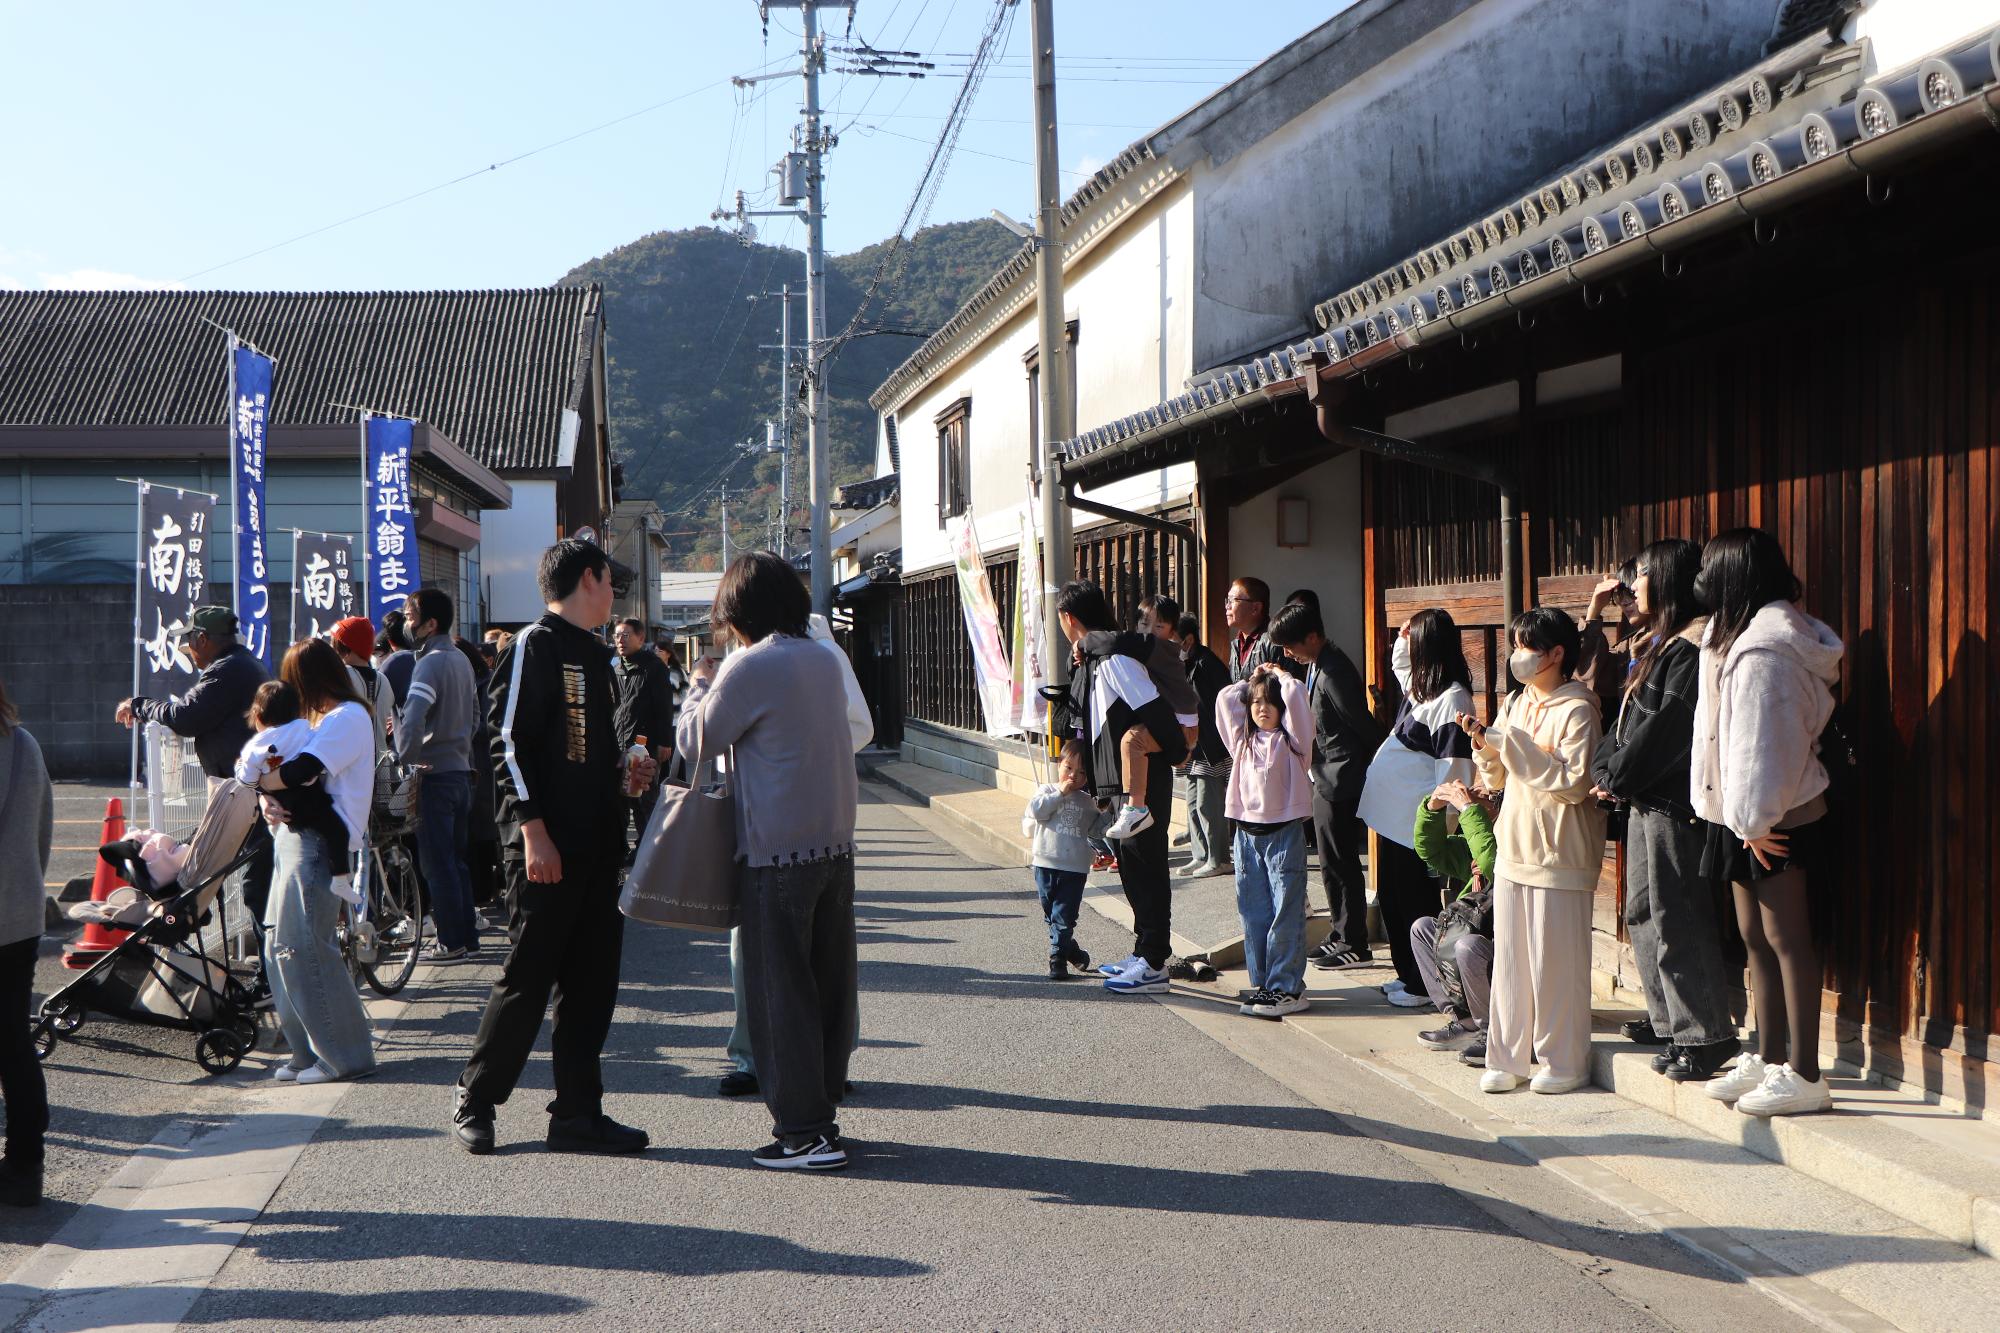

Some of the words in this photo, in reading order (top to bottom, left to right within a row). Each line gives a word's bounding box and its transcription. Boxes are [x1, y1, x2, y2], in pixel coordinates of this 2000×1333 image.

[186, 511, 205, 620] 引田投げ
[303, 552, 337, 639] 南
[335, 549, 353, 621] 引田投げ
[145, 513, 194, 704] 南奴
[1055, 823, 1082, 838] CARE
[627, 889, 679, 907] ONDATION
